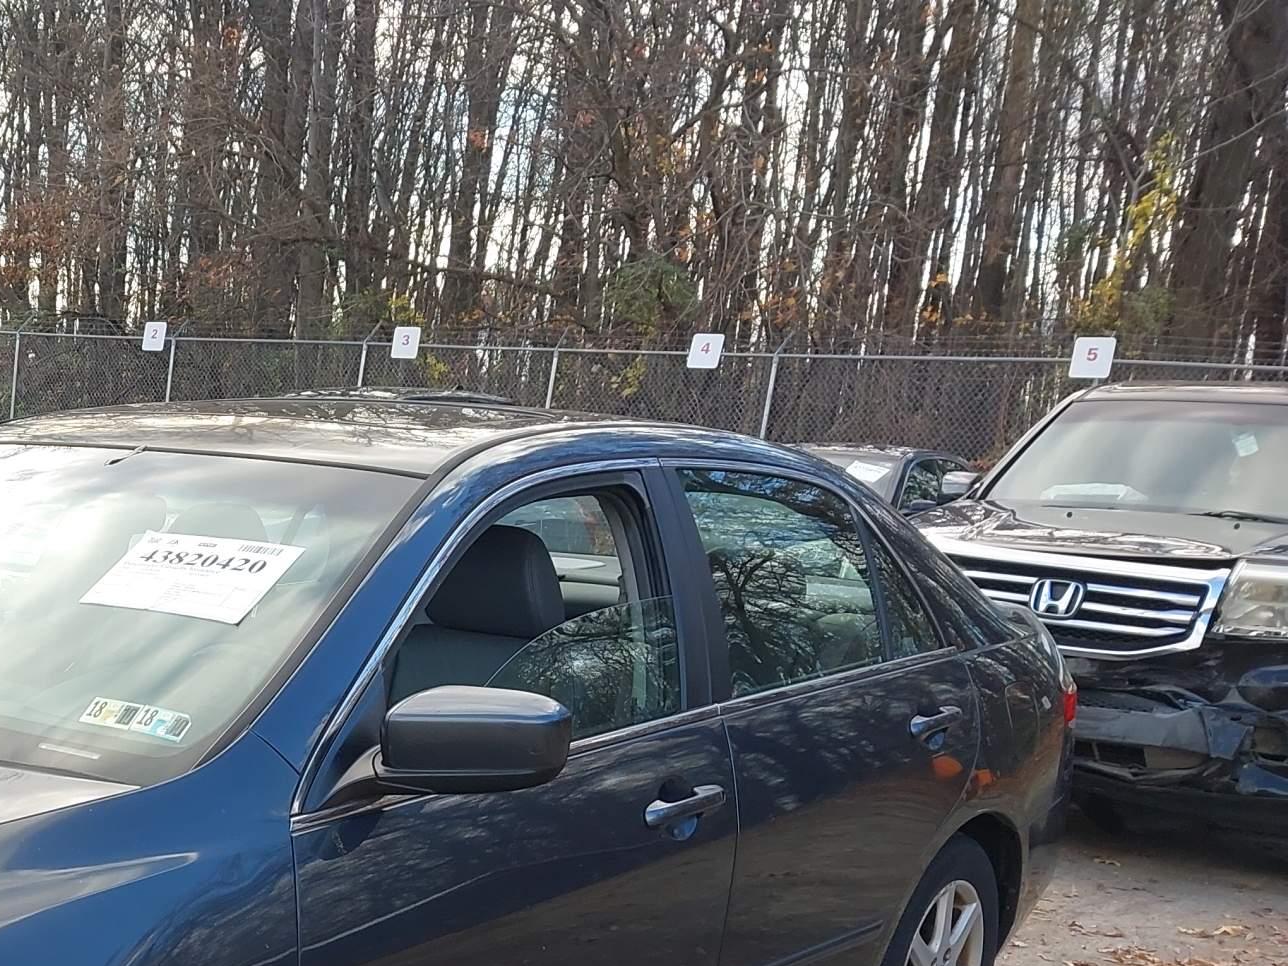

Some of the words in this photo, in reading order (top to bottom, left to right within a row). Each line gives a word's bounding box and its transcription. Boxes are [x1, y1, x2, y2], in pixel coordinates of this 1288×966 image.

[151, 329, 158, 339] 2
[402, 334, 410, 346] 3
[700, 342, 712, 354] 4
[1086, 347, 1099, 362] 5
[139, 548, 267, 574] 43820420
[86, 700, 108, 719] 18
[135, 708, 160, 727] 18
